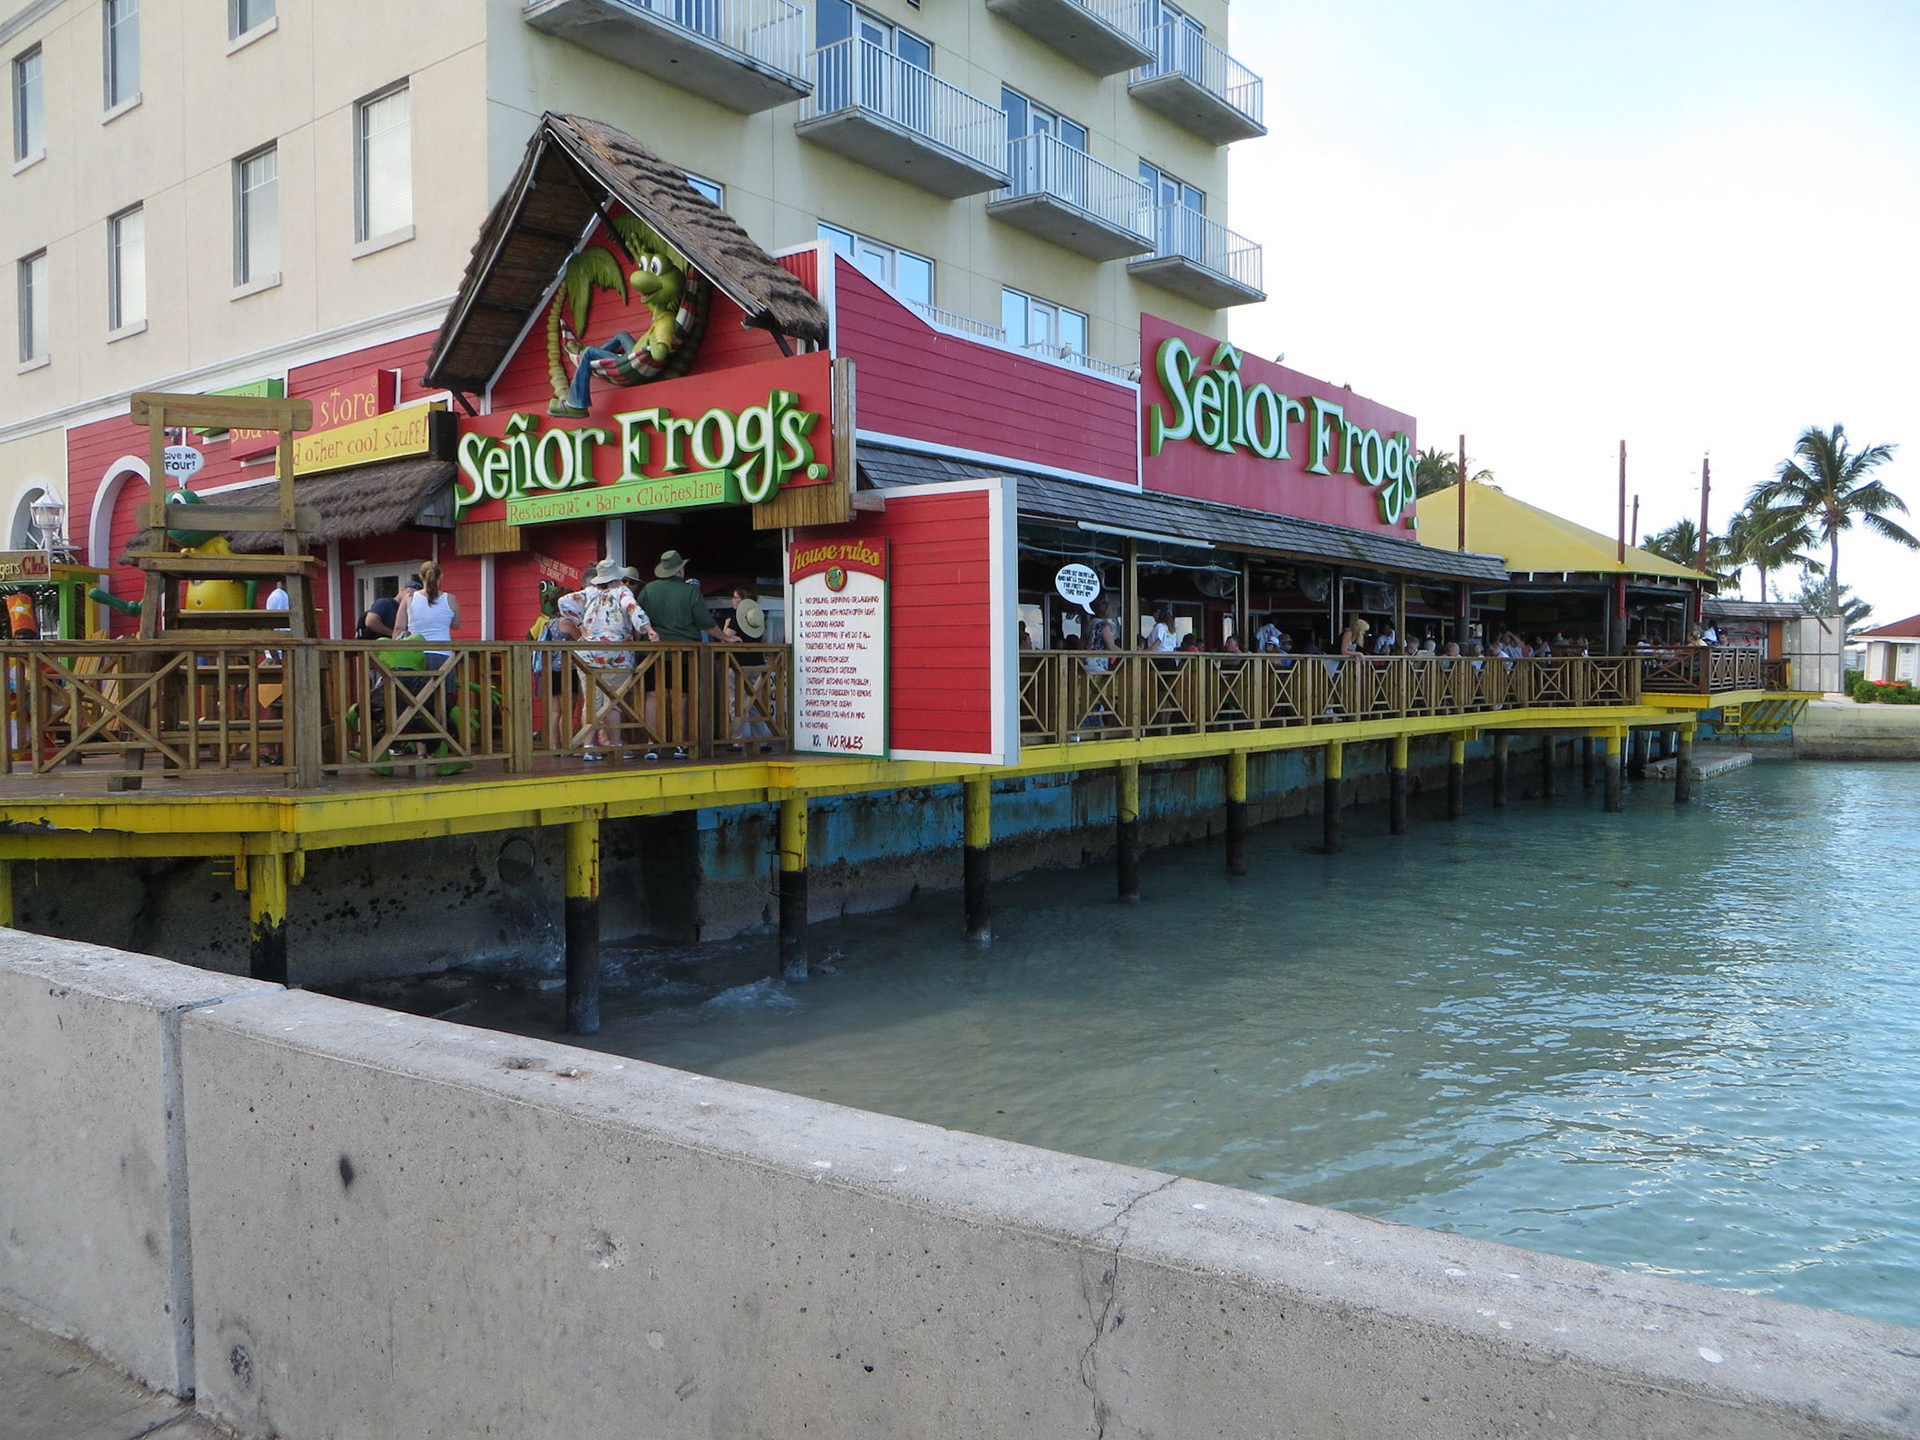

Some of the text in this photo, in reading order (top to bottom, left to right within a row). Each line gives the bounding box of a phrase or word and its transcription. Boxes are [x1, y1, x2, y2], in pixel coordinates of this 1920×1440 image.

[320, 388, 376, 428] store
[305, 439, 343, 463] other
[347, 429, 378, 455] cool
[384, 415, 428, 450] stuff!
[1150, 337, 1420, 525] Señor Frog's
[455, 389, 818, 520] Señor Frog's
[508, 479, 723, 522] Restaurant Bar Clothesline
[792, 540, 880, 573] house rules
[827, 735, 839, 748] NO
[840, 735, 864, 750] RULES
